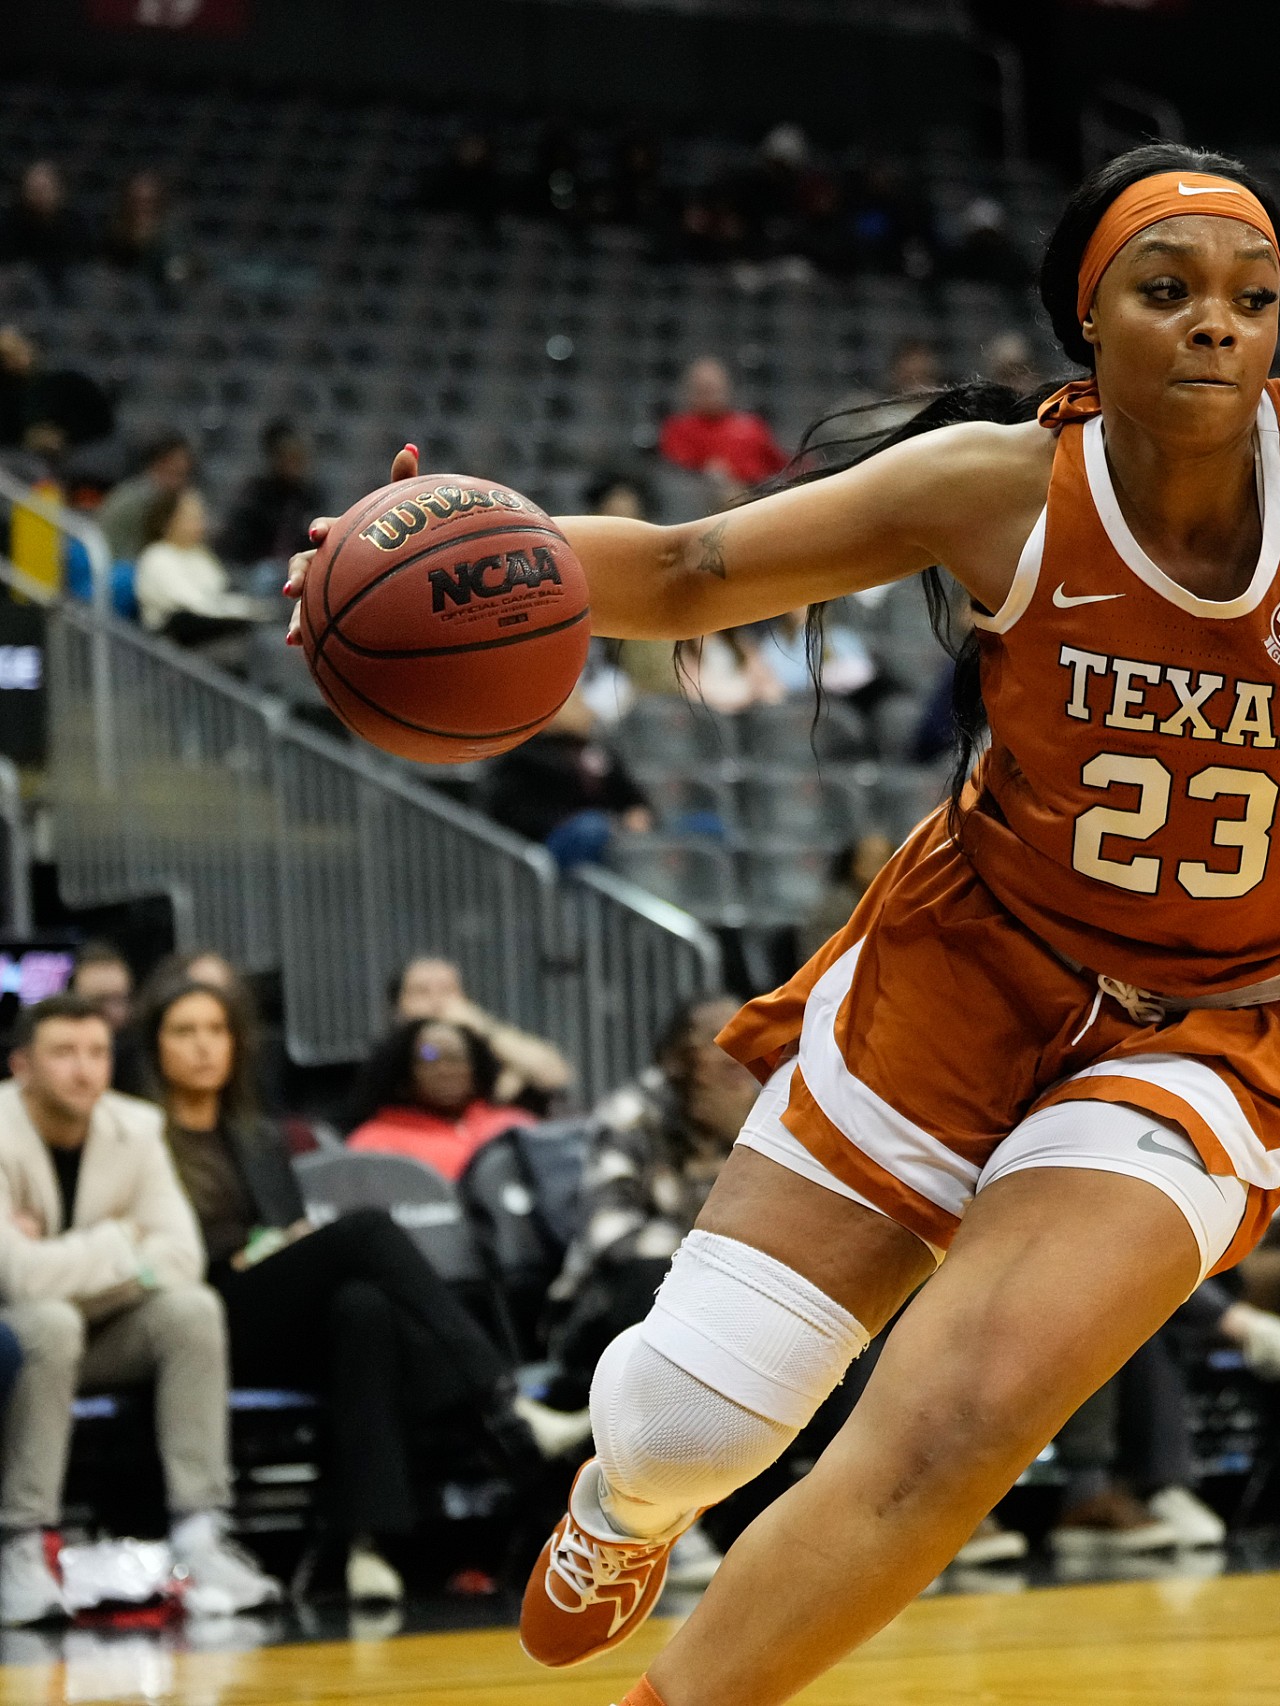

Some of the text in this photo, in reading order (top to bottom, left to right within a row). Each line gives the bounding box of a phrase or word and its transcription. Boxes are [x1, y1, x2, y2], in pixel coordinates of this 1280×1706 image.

[427, 546, 562, 614] NCAA
[501, 591, 536, 605] GAME
[538, 588, 565, 598] BALL
